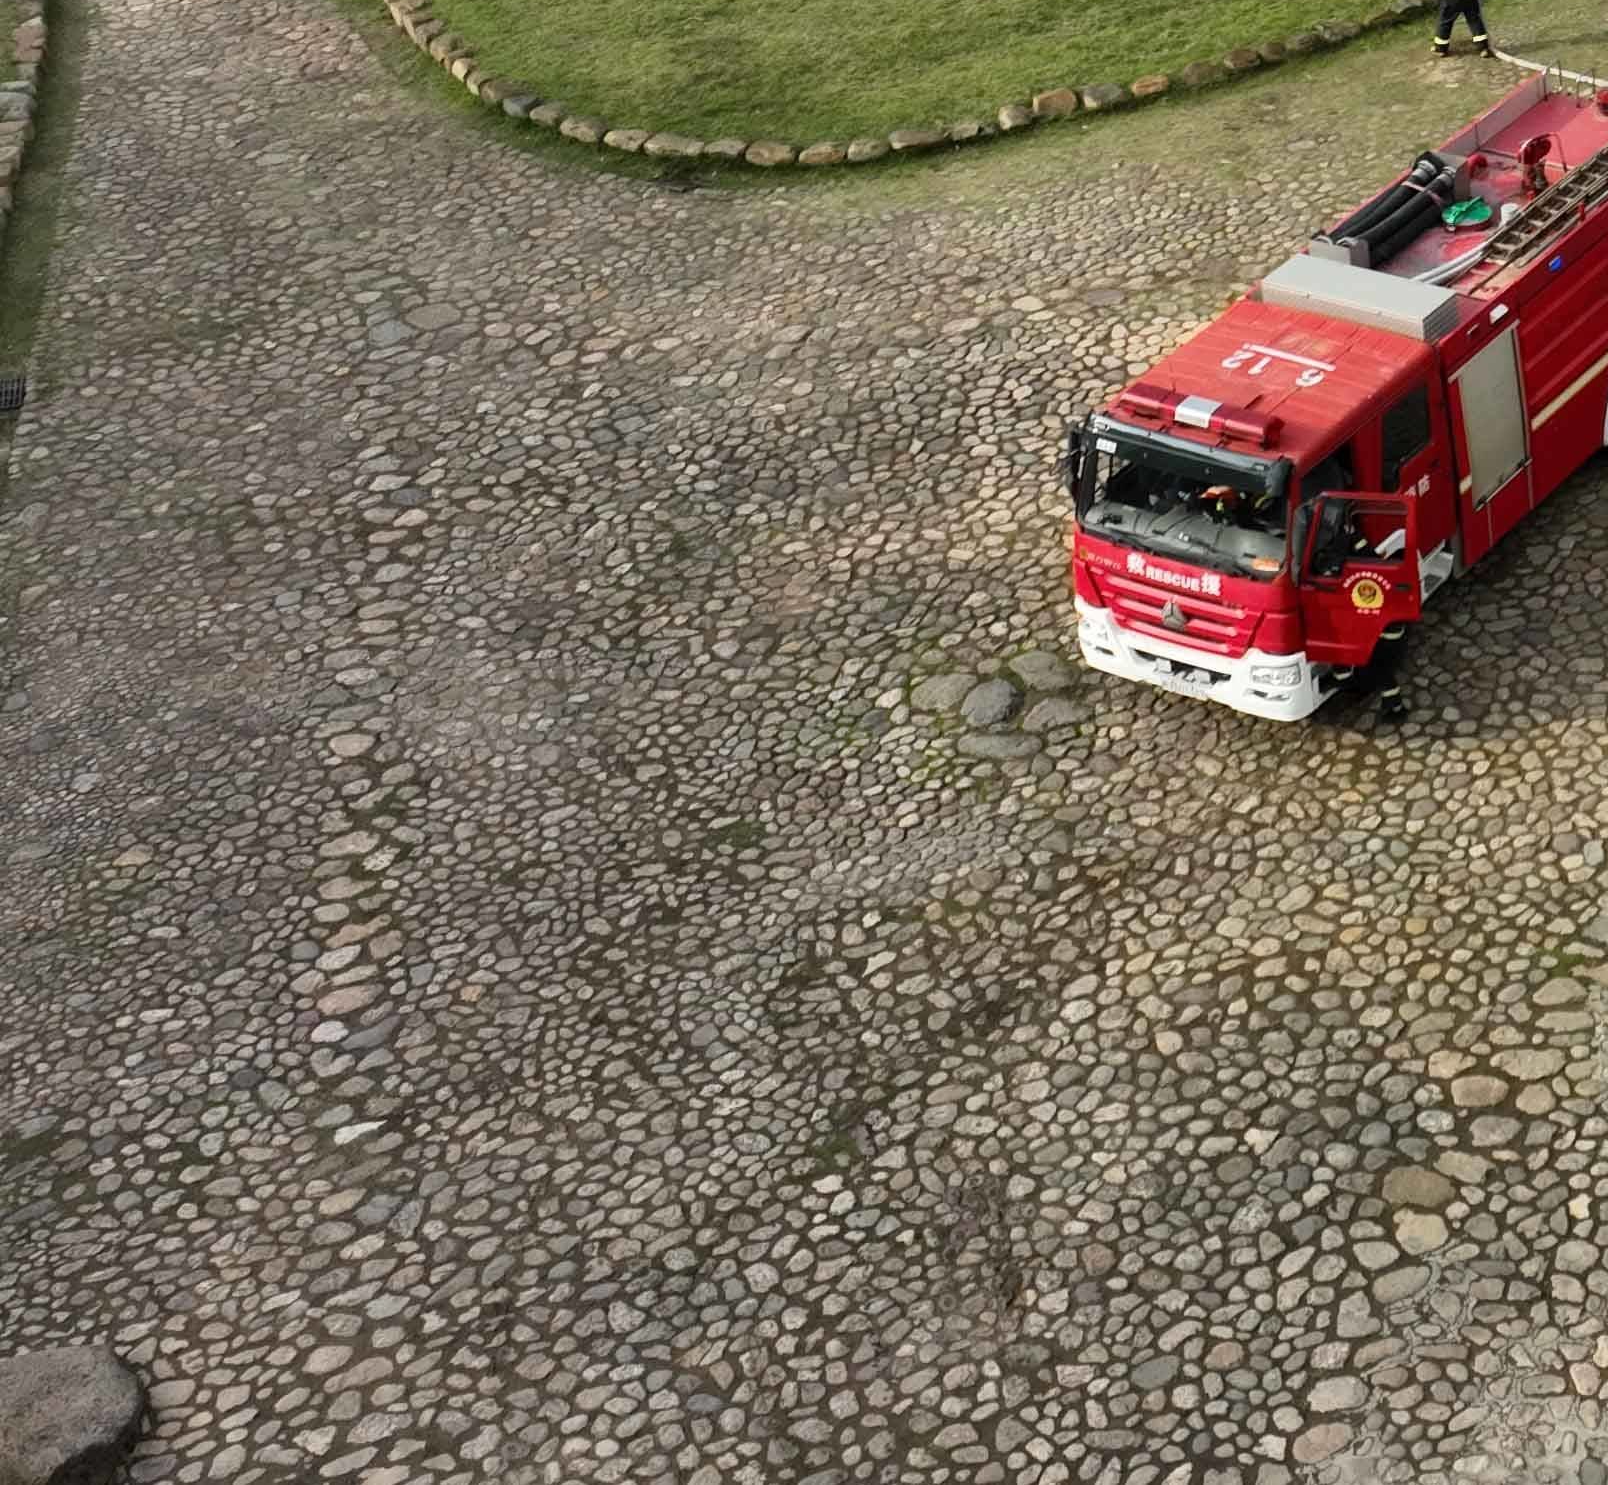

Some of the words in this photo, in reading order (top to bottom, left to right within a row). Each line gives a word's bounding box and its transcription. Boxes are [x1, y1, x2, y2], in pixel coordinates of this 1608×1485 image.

[1126, 552, 1147, 576] 救
[1145, 565, 1200, 592] RESCUE
[1200, 571, 1221, 596] 援
